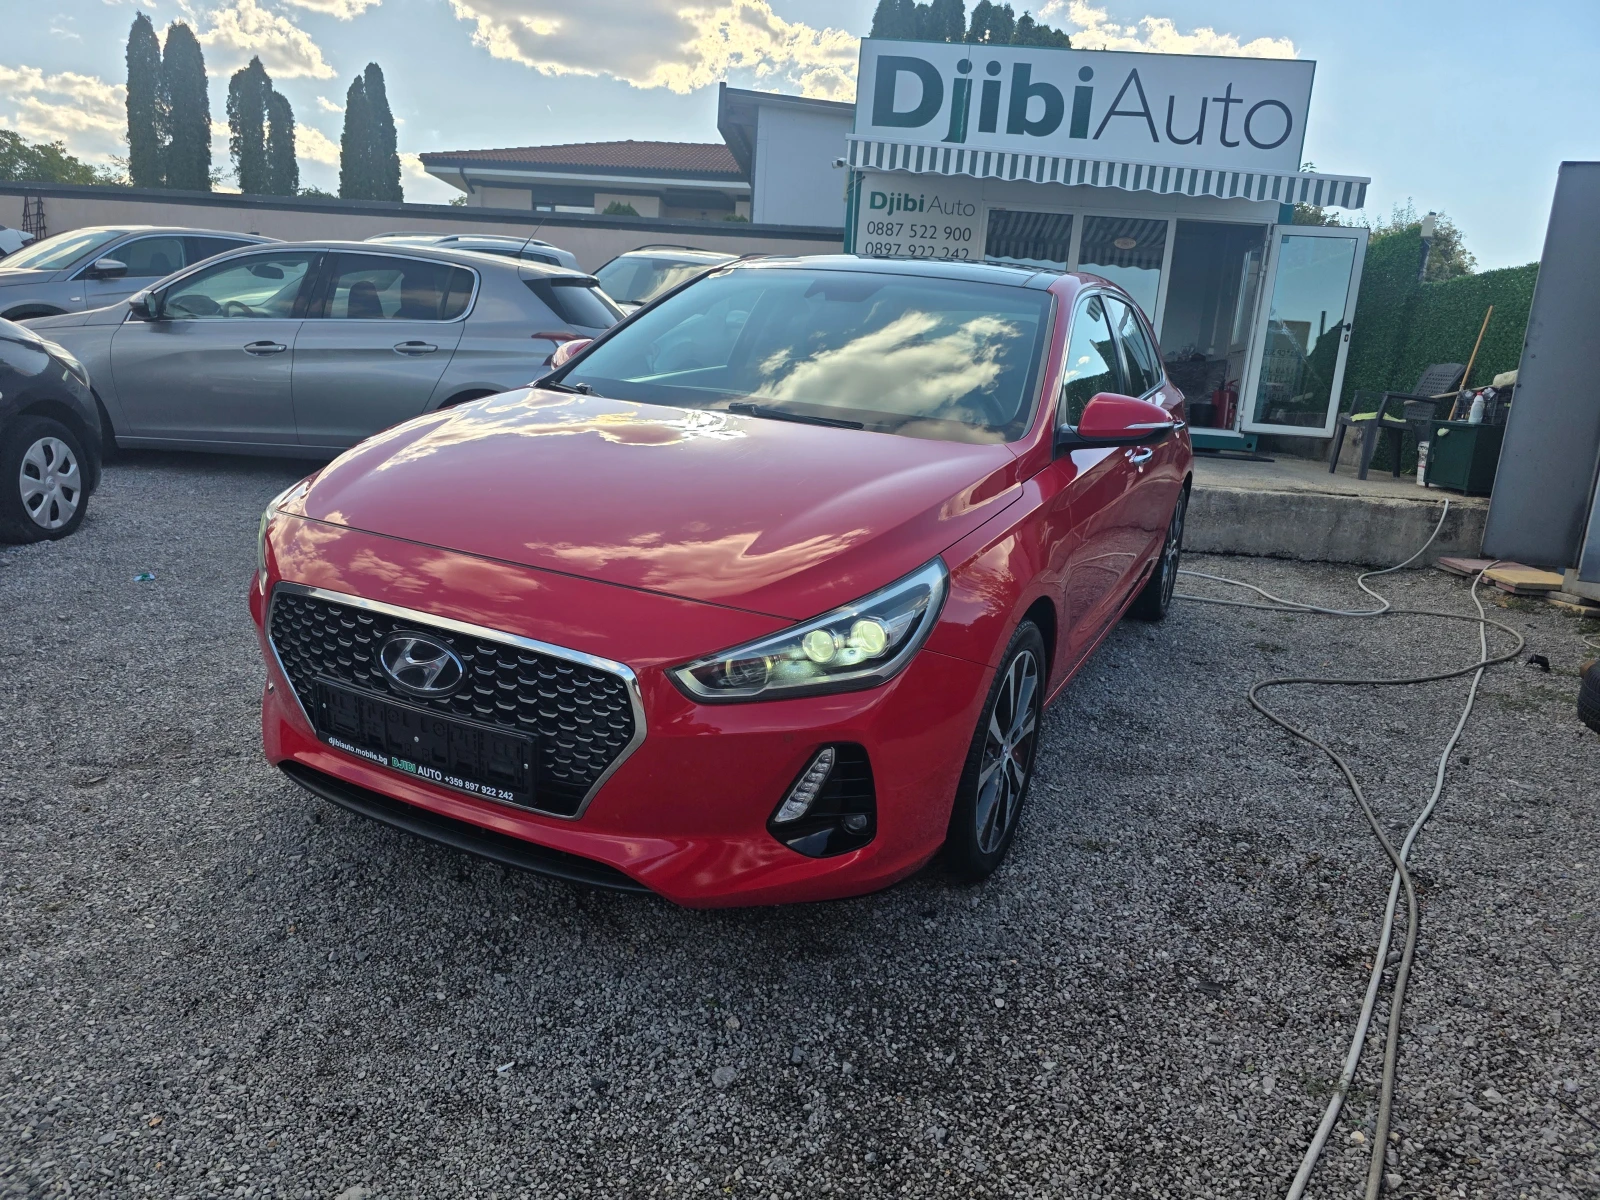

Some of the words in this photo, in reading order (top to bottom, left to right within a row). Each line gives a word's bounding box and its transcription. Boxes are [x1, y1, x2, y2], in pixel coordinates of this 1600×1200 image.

[867, 221, 904, 237] 0887
[909, 224, 937, 240] 522
[943, 226, 972, 242] 900
[865, 242, 902, 255] 0897
[328, 736, 388, 766] djibiauto.mobile.bg
[391, 756, 417, 773] DJIBI
[417, 765, 442, 781] AUTO
[444, 775, 463, 788] +359
[464, 780, 480, 792] 897
[481, 785, 497, 797] 922
[498, 789, 514, 801] 242
